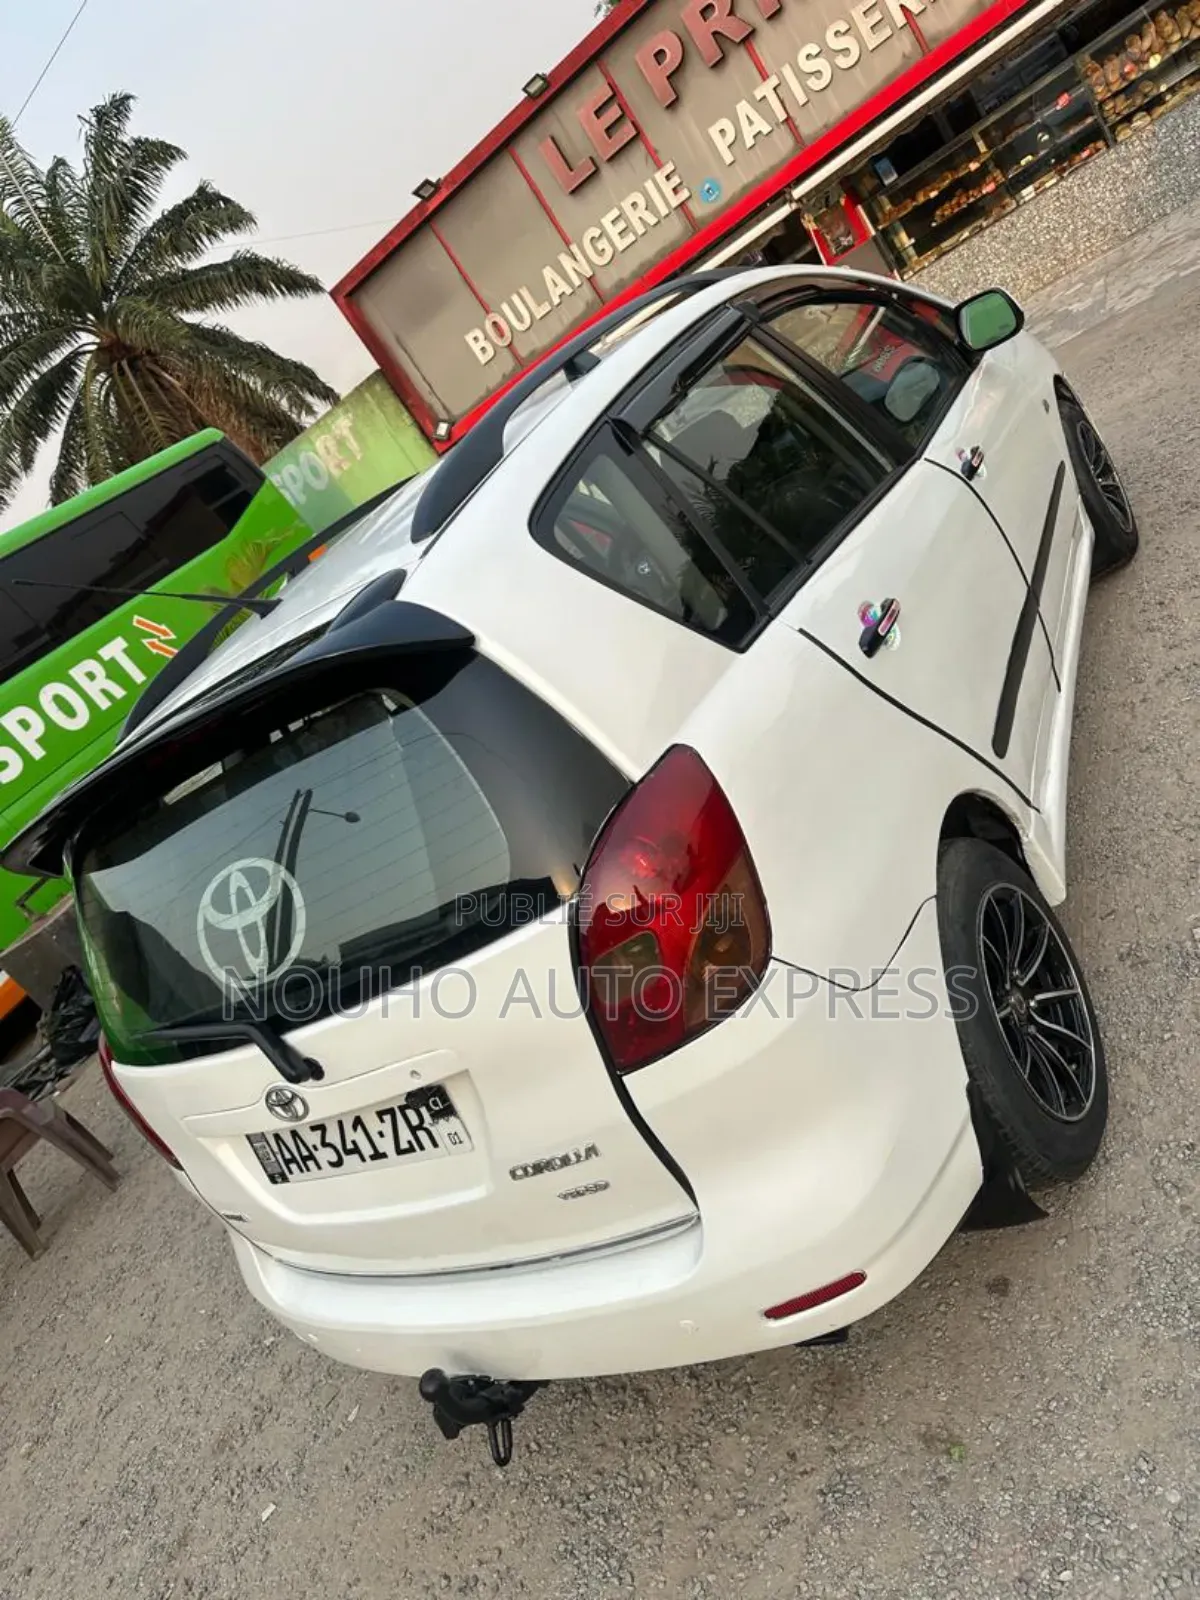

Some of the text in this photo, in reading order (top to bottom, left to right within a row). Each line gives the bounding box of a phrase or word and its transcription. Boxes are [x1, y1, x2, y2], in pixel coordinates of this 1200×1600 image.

[464, 0, 935, 366] BOULANGERIE PATISSE
[541, 0, 783, 196] LE PR
[428, 1097, 443, 1111] CI
